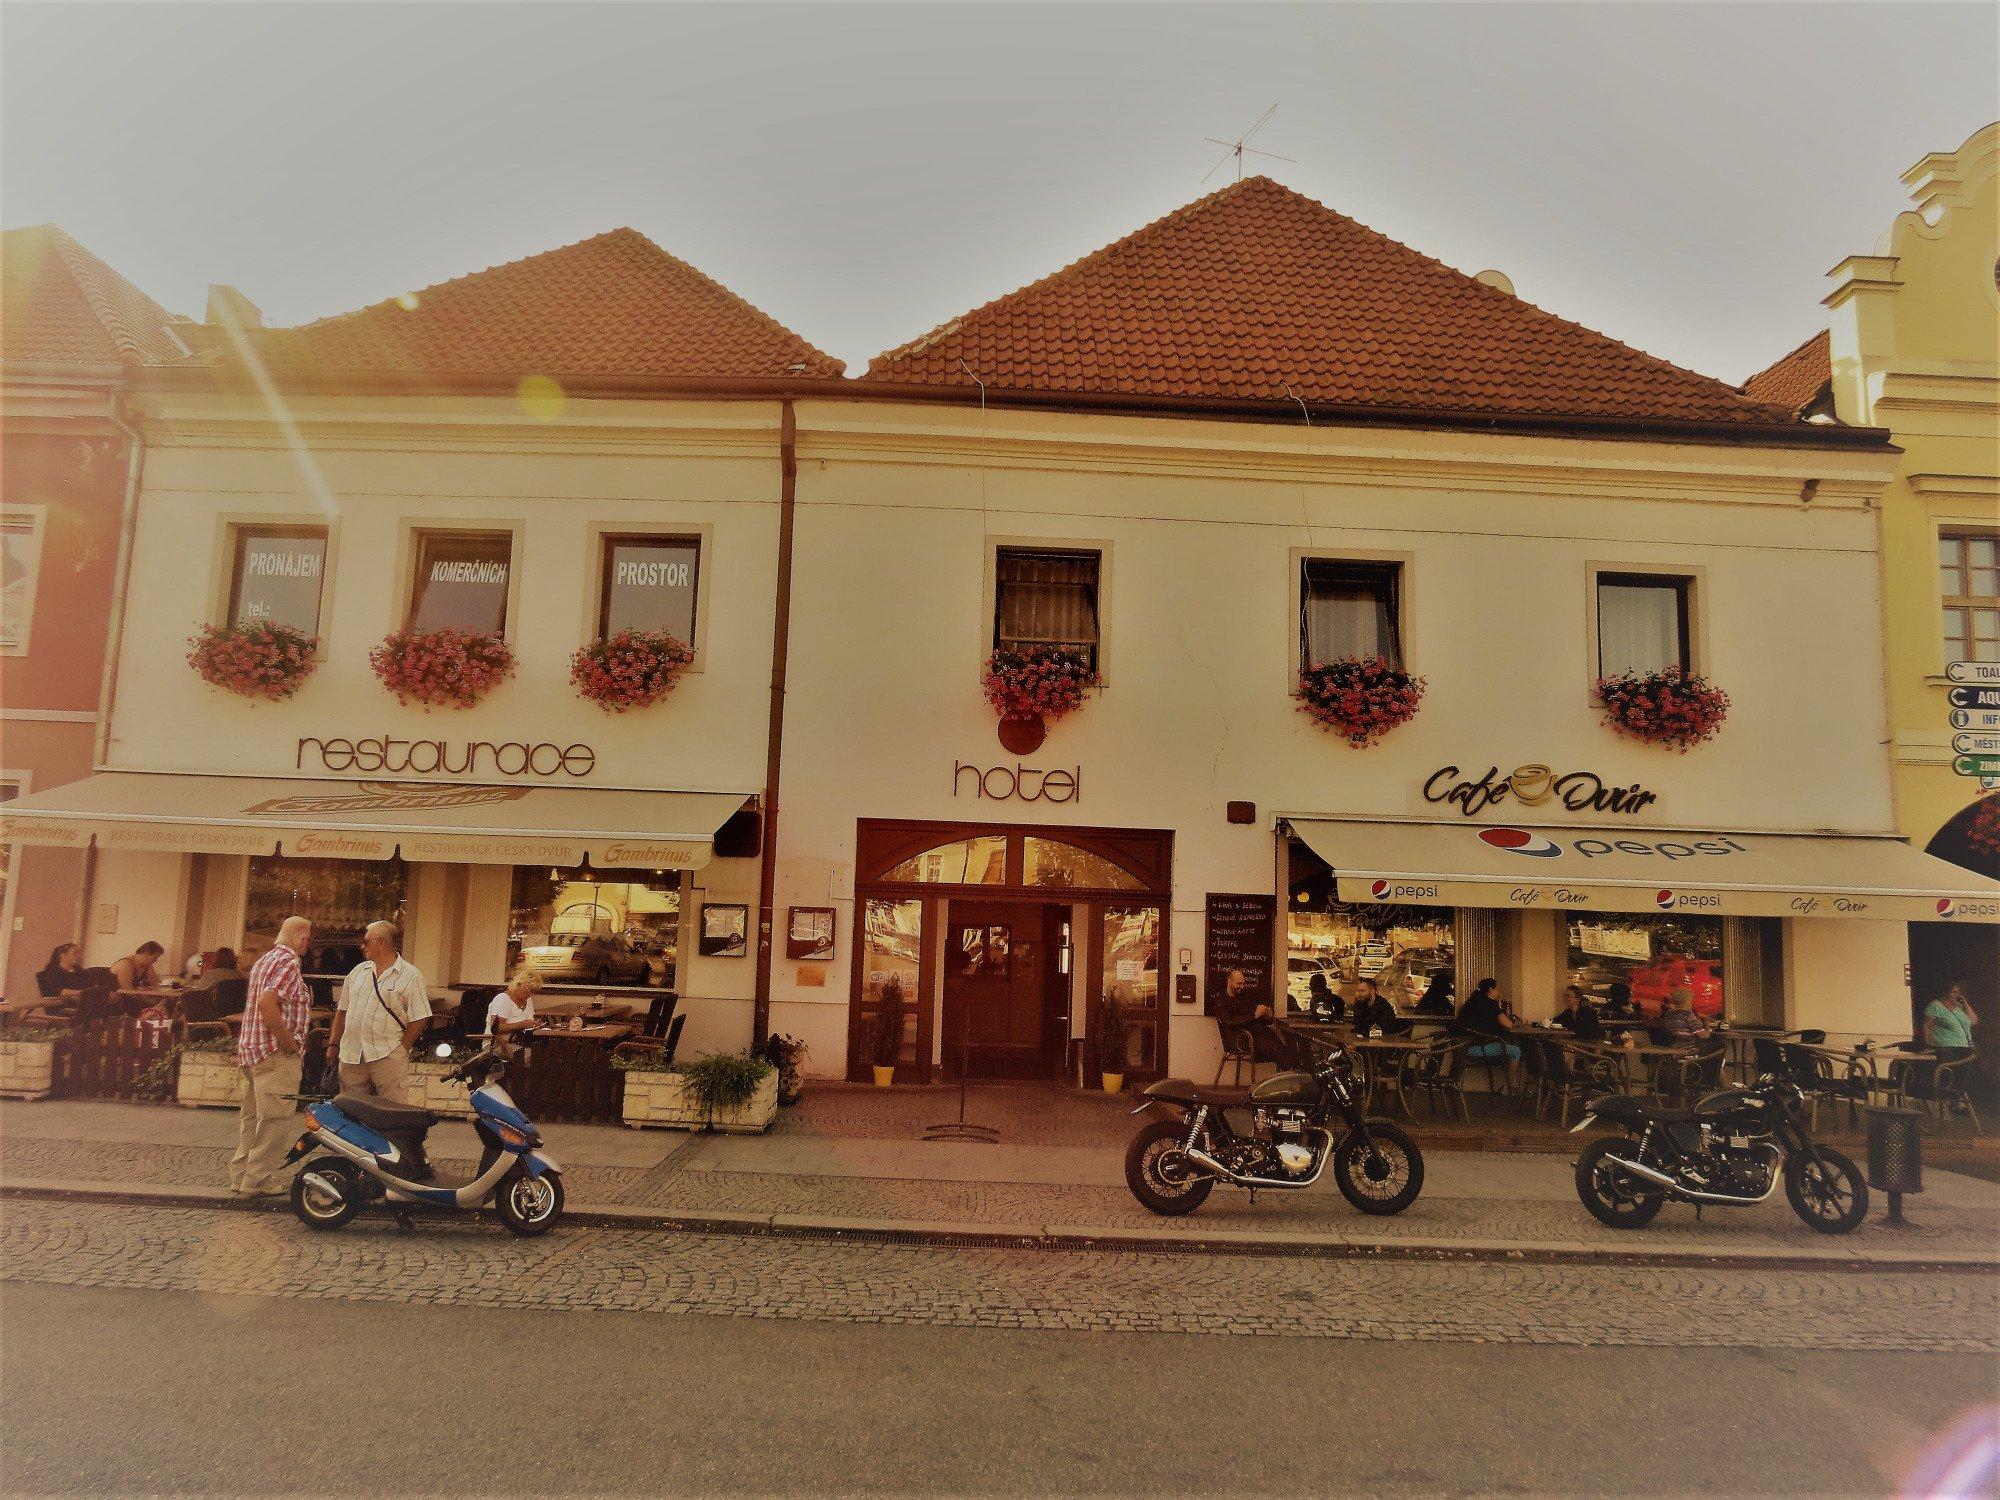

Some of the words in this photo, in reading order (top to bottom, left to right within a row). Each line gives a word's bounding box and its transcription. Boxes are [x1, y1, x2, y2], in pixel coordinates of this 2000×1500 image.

[249, 551, 322, 577] PRONÁJEM
[430, 559, 508, 584] KOMERČNÍCH
[617, 560, 689, 587] PROSTOR
[1982, 713, 2000, 725] INF
[296, 734, 596, 777] restaurace
[953, 759, 1081, 804] hotel
[110, 829, 187, 844] RESTAURACE
[297, 833, 383, 854] Gambrinus
[414, 842, 492, 856] RESTAURACE
[604, 843, 693, 864] Gambrinus
[1572, 837, 1747, 861] pepsi
[1394, 885, 1438, 900] pepsi
[1510, 888, 1541, 905] Café
[1679, 893, 1721, 909] pepsi
[1958, 903, 2000, 917] pepsi
